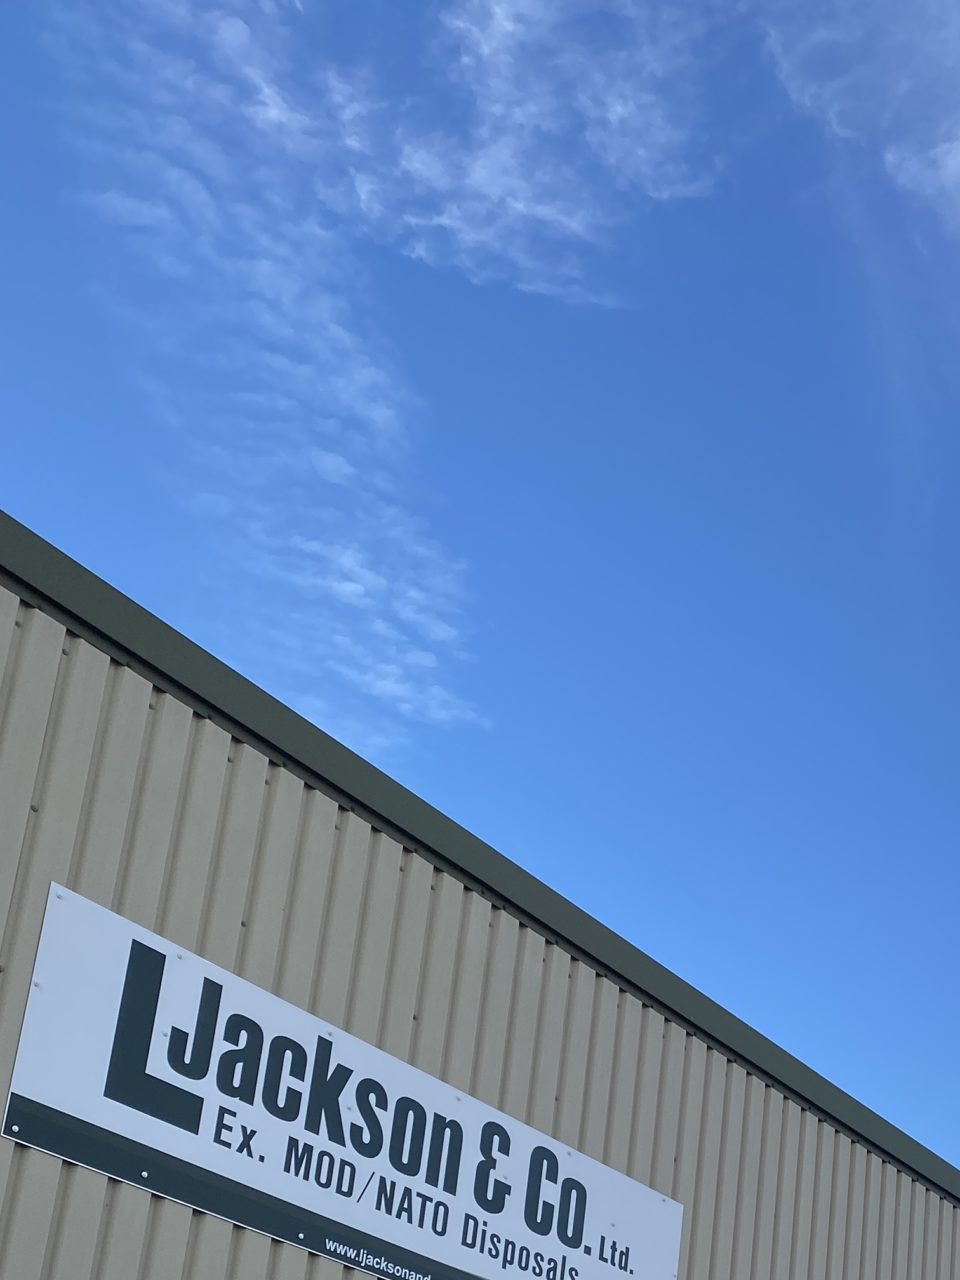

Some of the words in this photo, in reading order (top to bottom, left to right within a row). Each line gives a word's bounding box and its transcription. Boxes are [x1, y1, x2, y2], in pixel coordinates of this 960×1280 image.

[213, 1104, 265, 1164] Ex.
[283, 1138, 449, 1238] MOD/NATO
[474, 1121, 512, 1215] &
[524, 1145, 593, 1256] Co.
[599, 1234, 635, 1276] Ltd.
